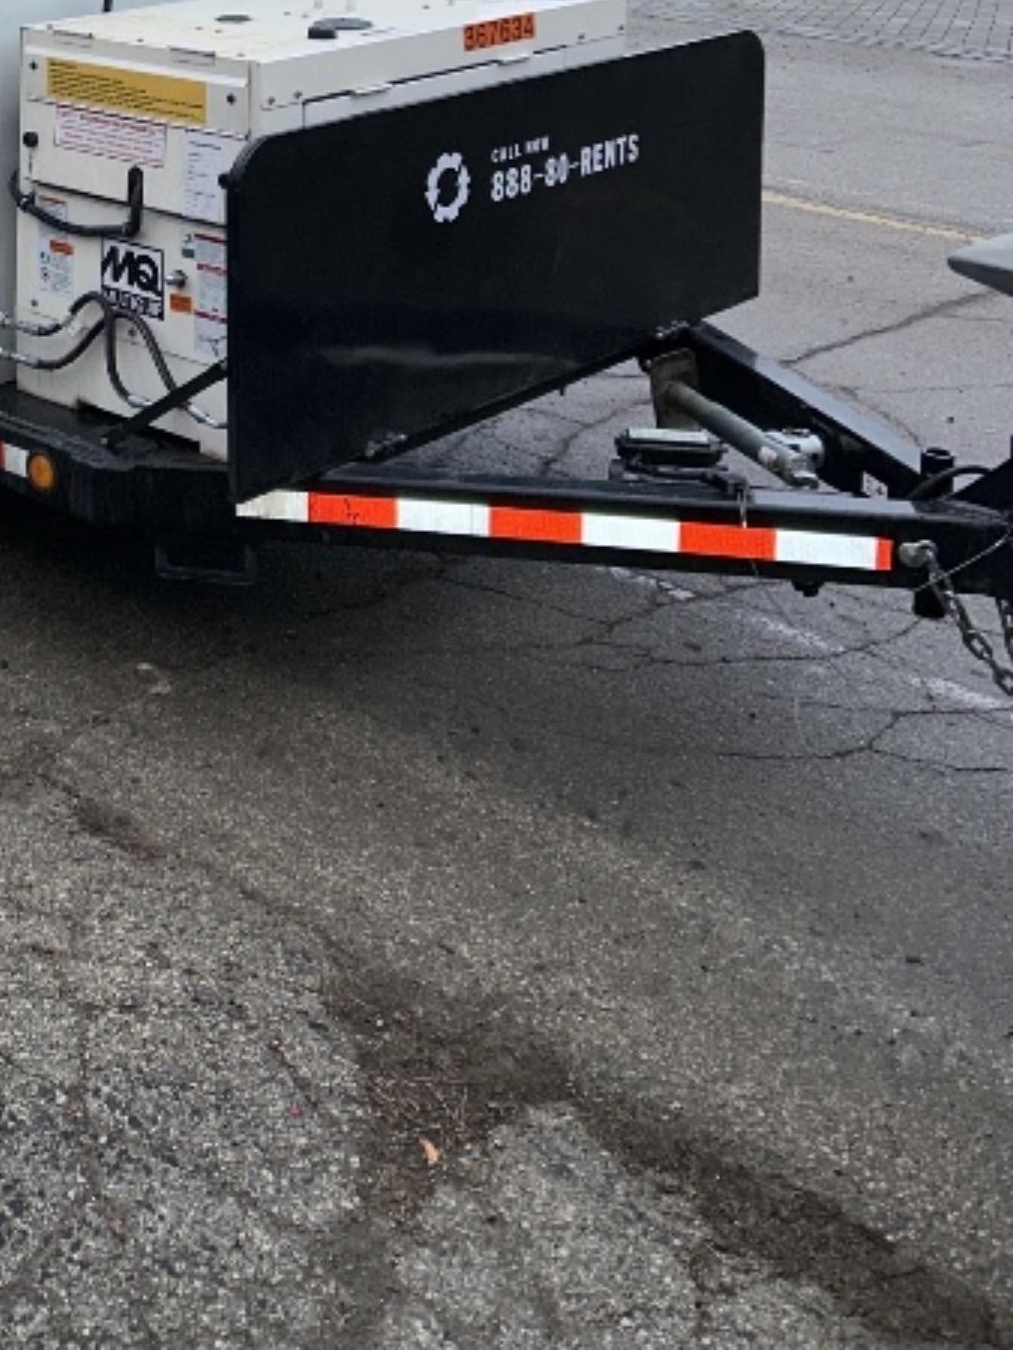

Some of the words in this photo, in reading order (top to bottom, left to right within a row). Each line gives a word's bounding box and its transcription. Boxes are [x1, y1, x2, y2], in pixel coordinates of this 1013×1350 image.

[463, 13, 535, 51] 367634
[491, 143, 522, 163] CALL
[525, 136, 550, 154] NOW
[491, 133, 640, 202] 888-80-RENTS
[101, 245, 162, 295] MQ
